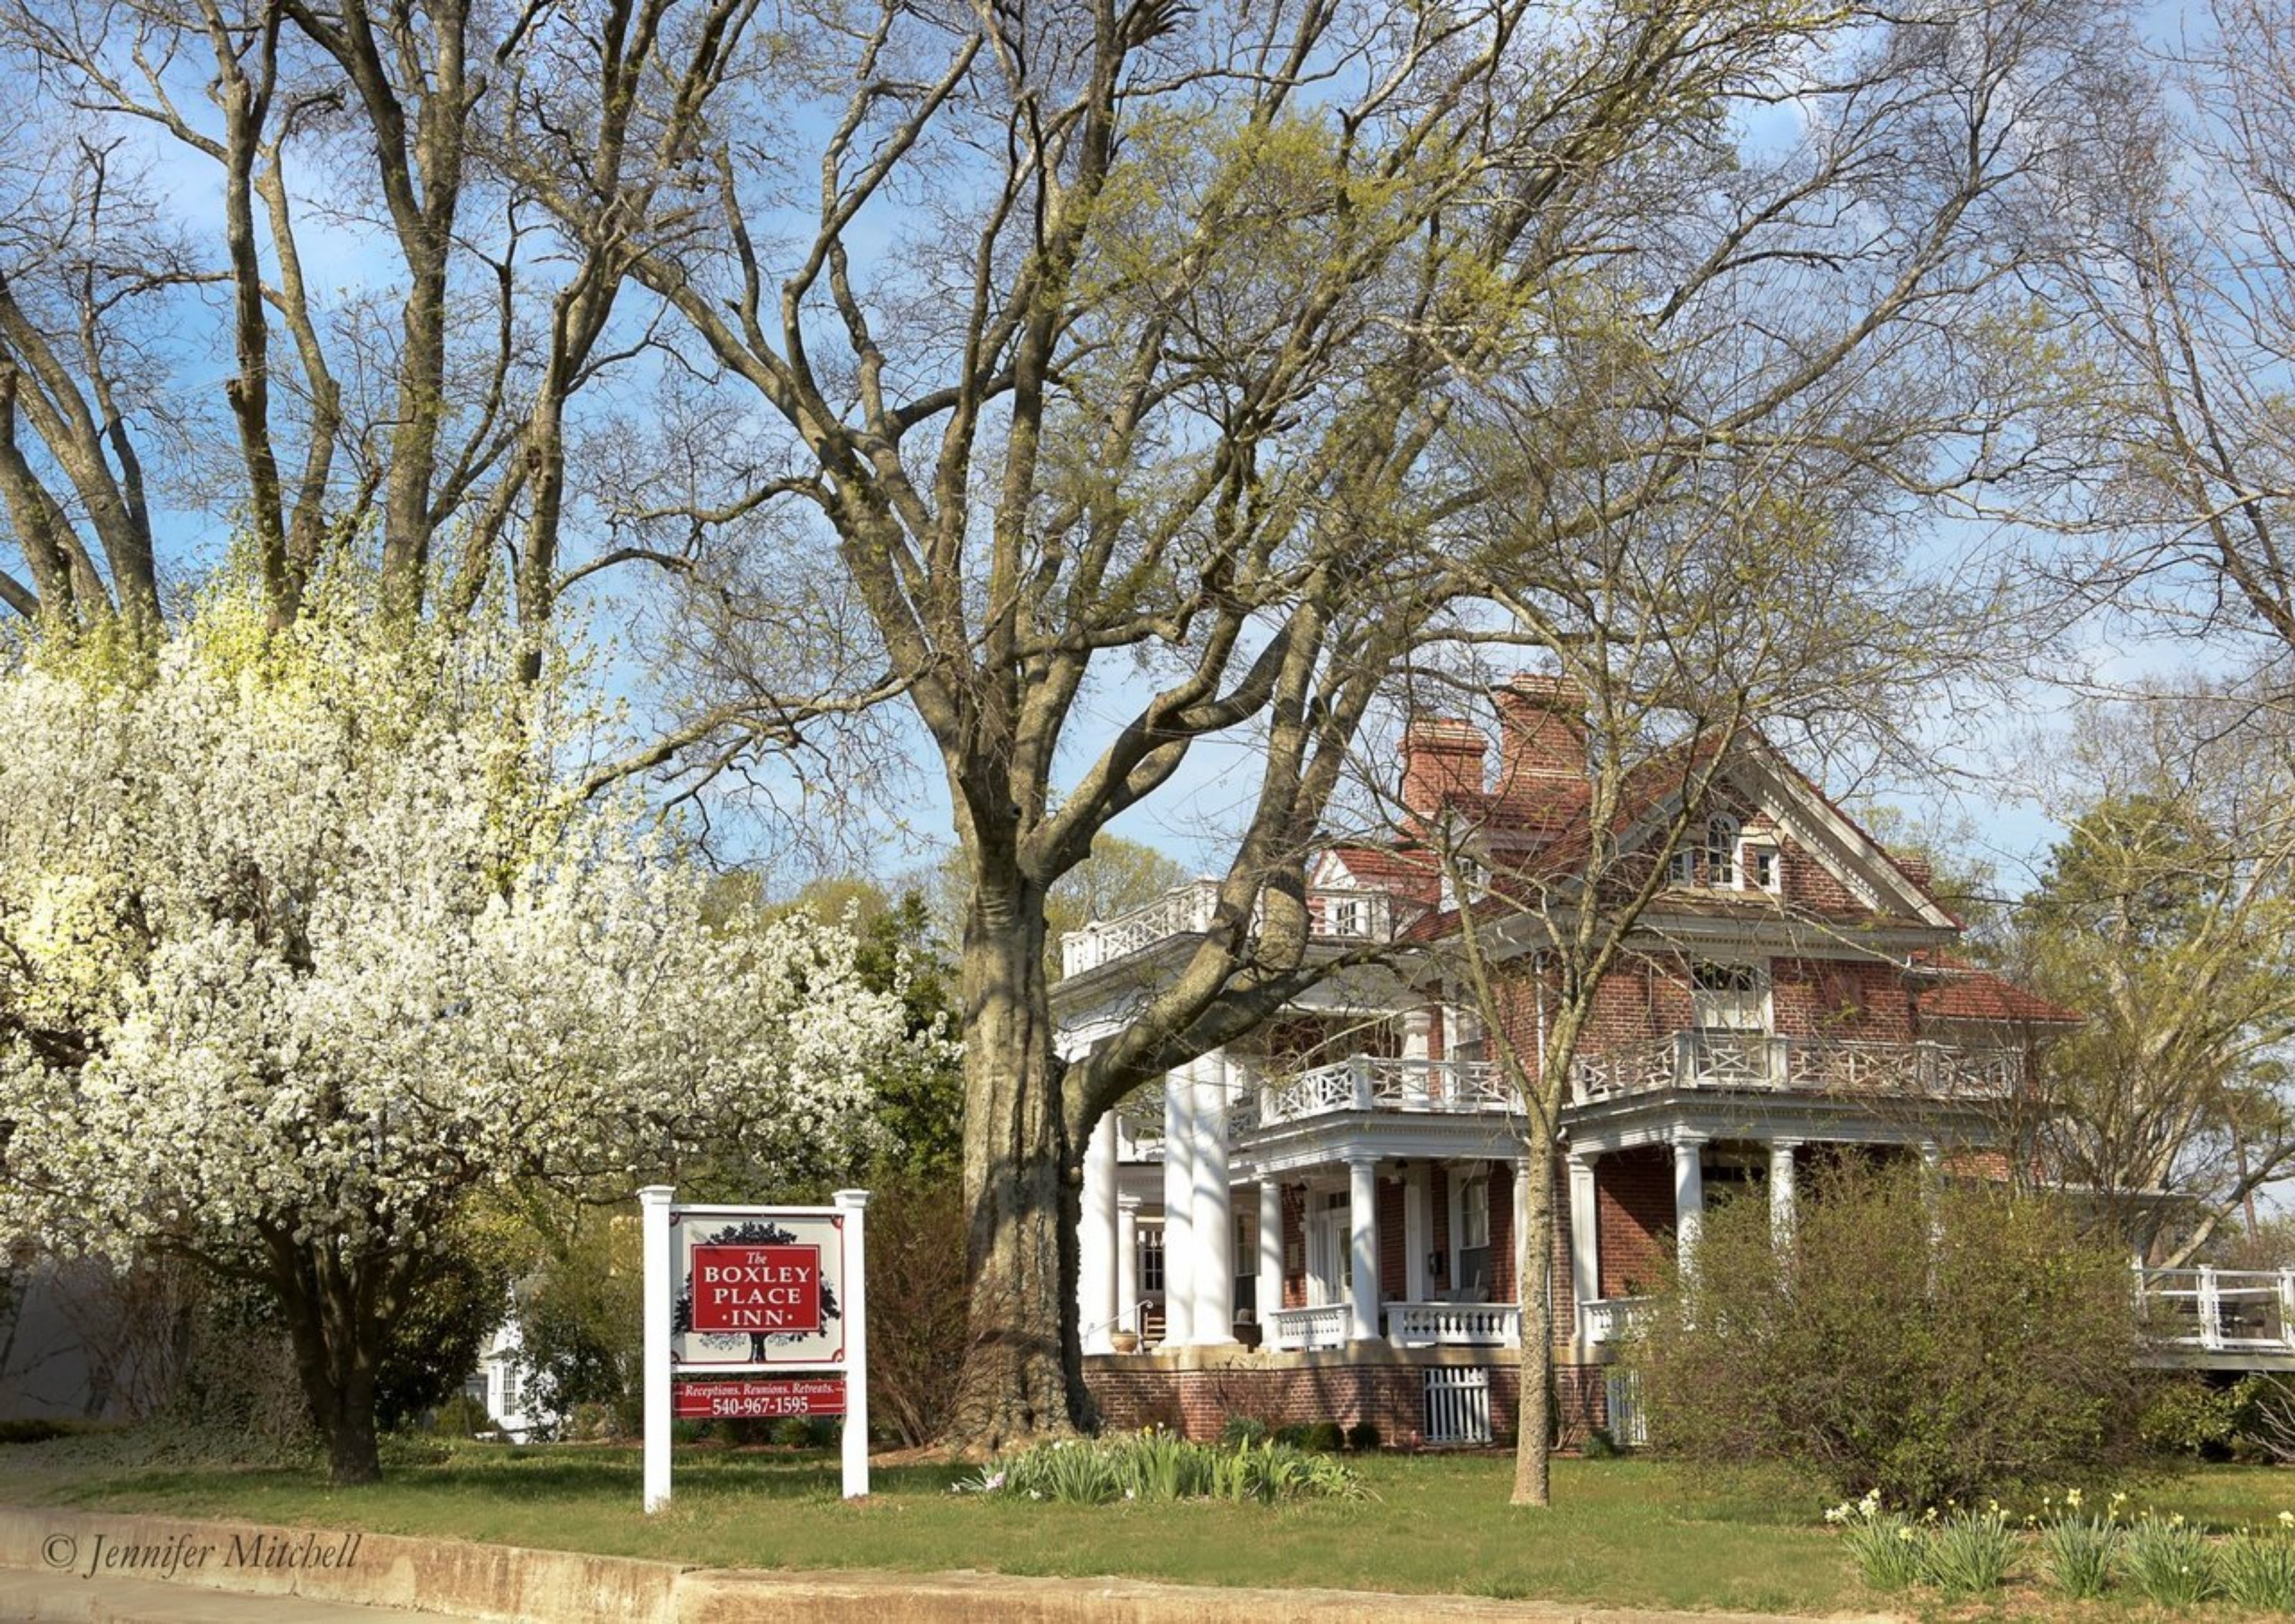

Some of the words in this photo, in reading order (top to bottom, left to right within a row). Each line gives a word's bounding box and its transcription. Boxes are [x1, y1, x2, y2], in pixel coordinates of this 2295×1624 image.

[746, 1252, 768, 1265] The
[704, 1266, 810, 1283] BOXLEY
[714, 1288, 802, 1304] PLACE
[712, 1397, 808, 1415] 540-967-1595
